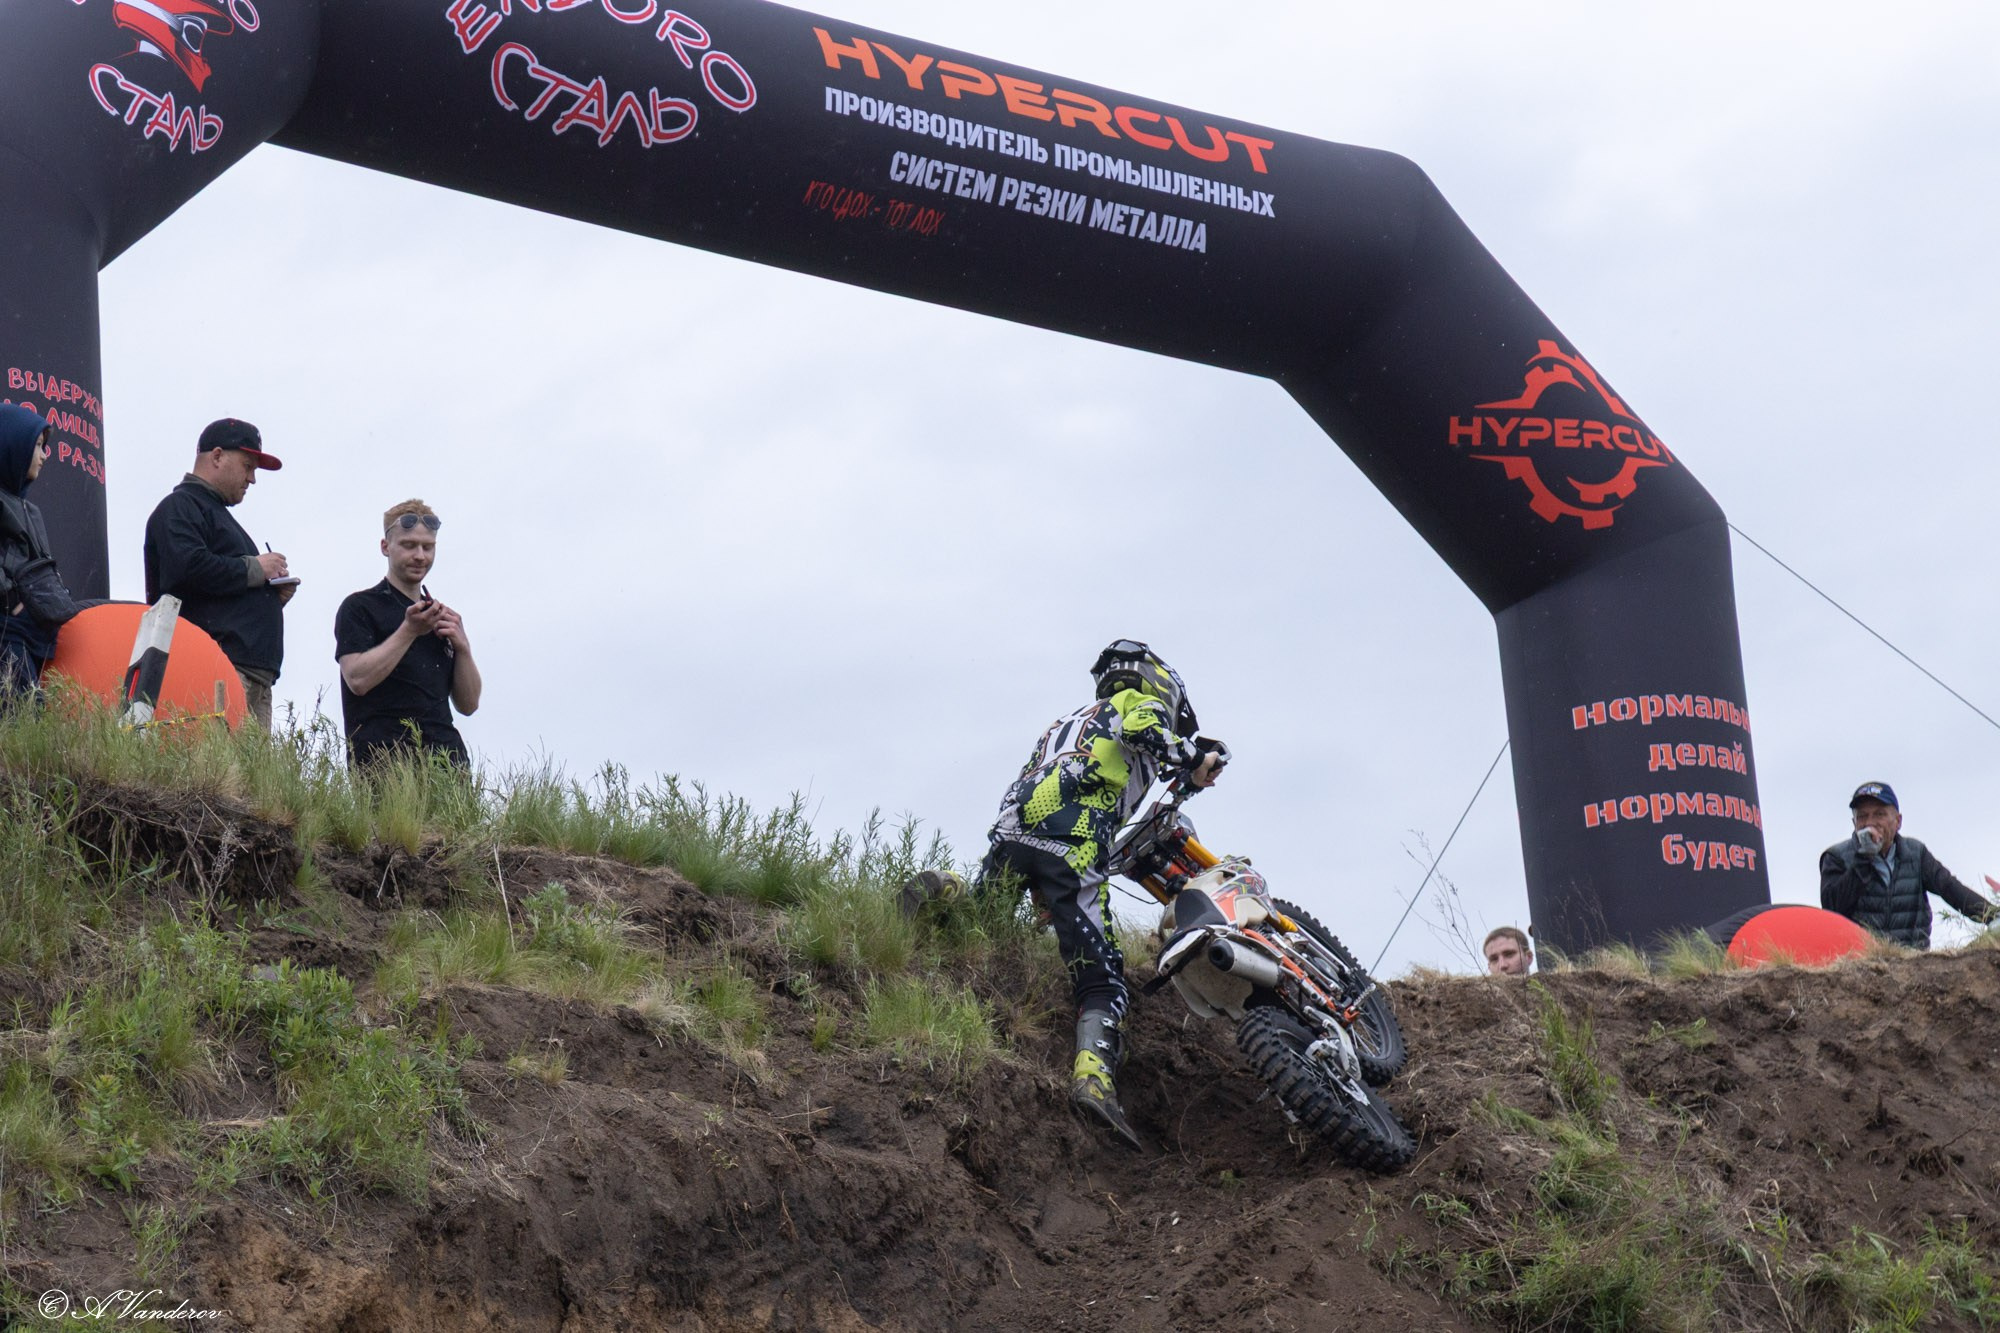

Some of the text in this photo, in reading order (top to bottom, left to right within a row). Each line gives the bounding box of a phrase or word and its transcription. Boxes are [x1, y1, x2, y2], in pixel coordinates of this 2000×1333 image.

[88, 63, 223, 154] СТАЛЬ
[491, 41, 698, 148] СТАЛЬ
[812, 26, 1275, 174] HYPERCUT
[825, 86, 1276, 218] ПРОИЗВОДИТЕЛЬ ПРОМЫШЛЕННЫХ
[803, 180, 835, 209] КТО
[832, 187, 876, 221] СДОХ
[886, 199, 915, 228] ТОТ
[910, 206, 946, 235] ЛОХ
[889, 150, 1207, 254] СИСТЕМ РЕЗКИ МЕТАЛЛА
[1449, 416, 1674, 463] HYPERCUT
[1649, 741, 1747, 775] делай
[1661, 833, 1756, 871] будет
